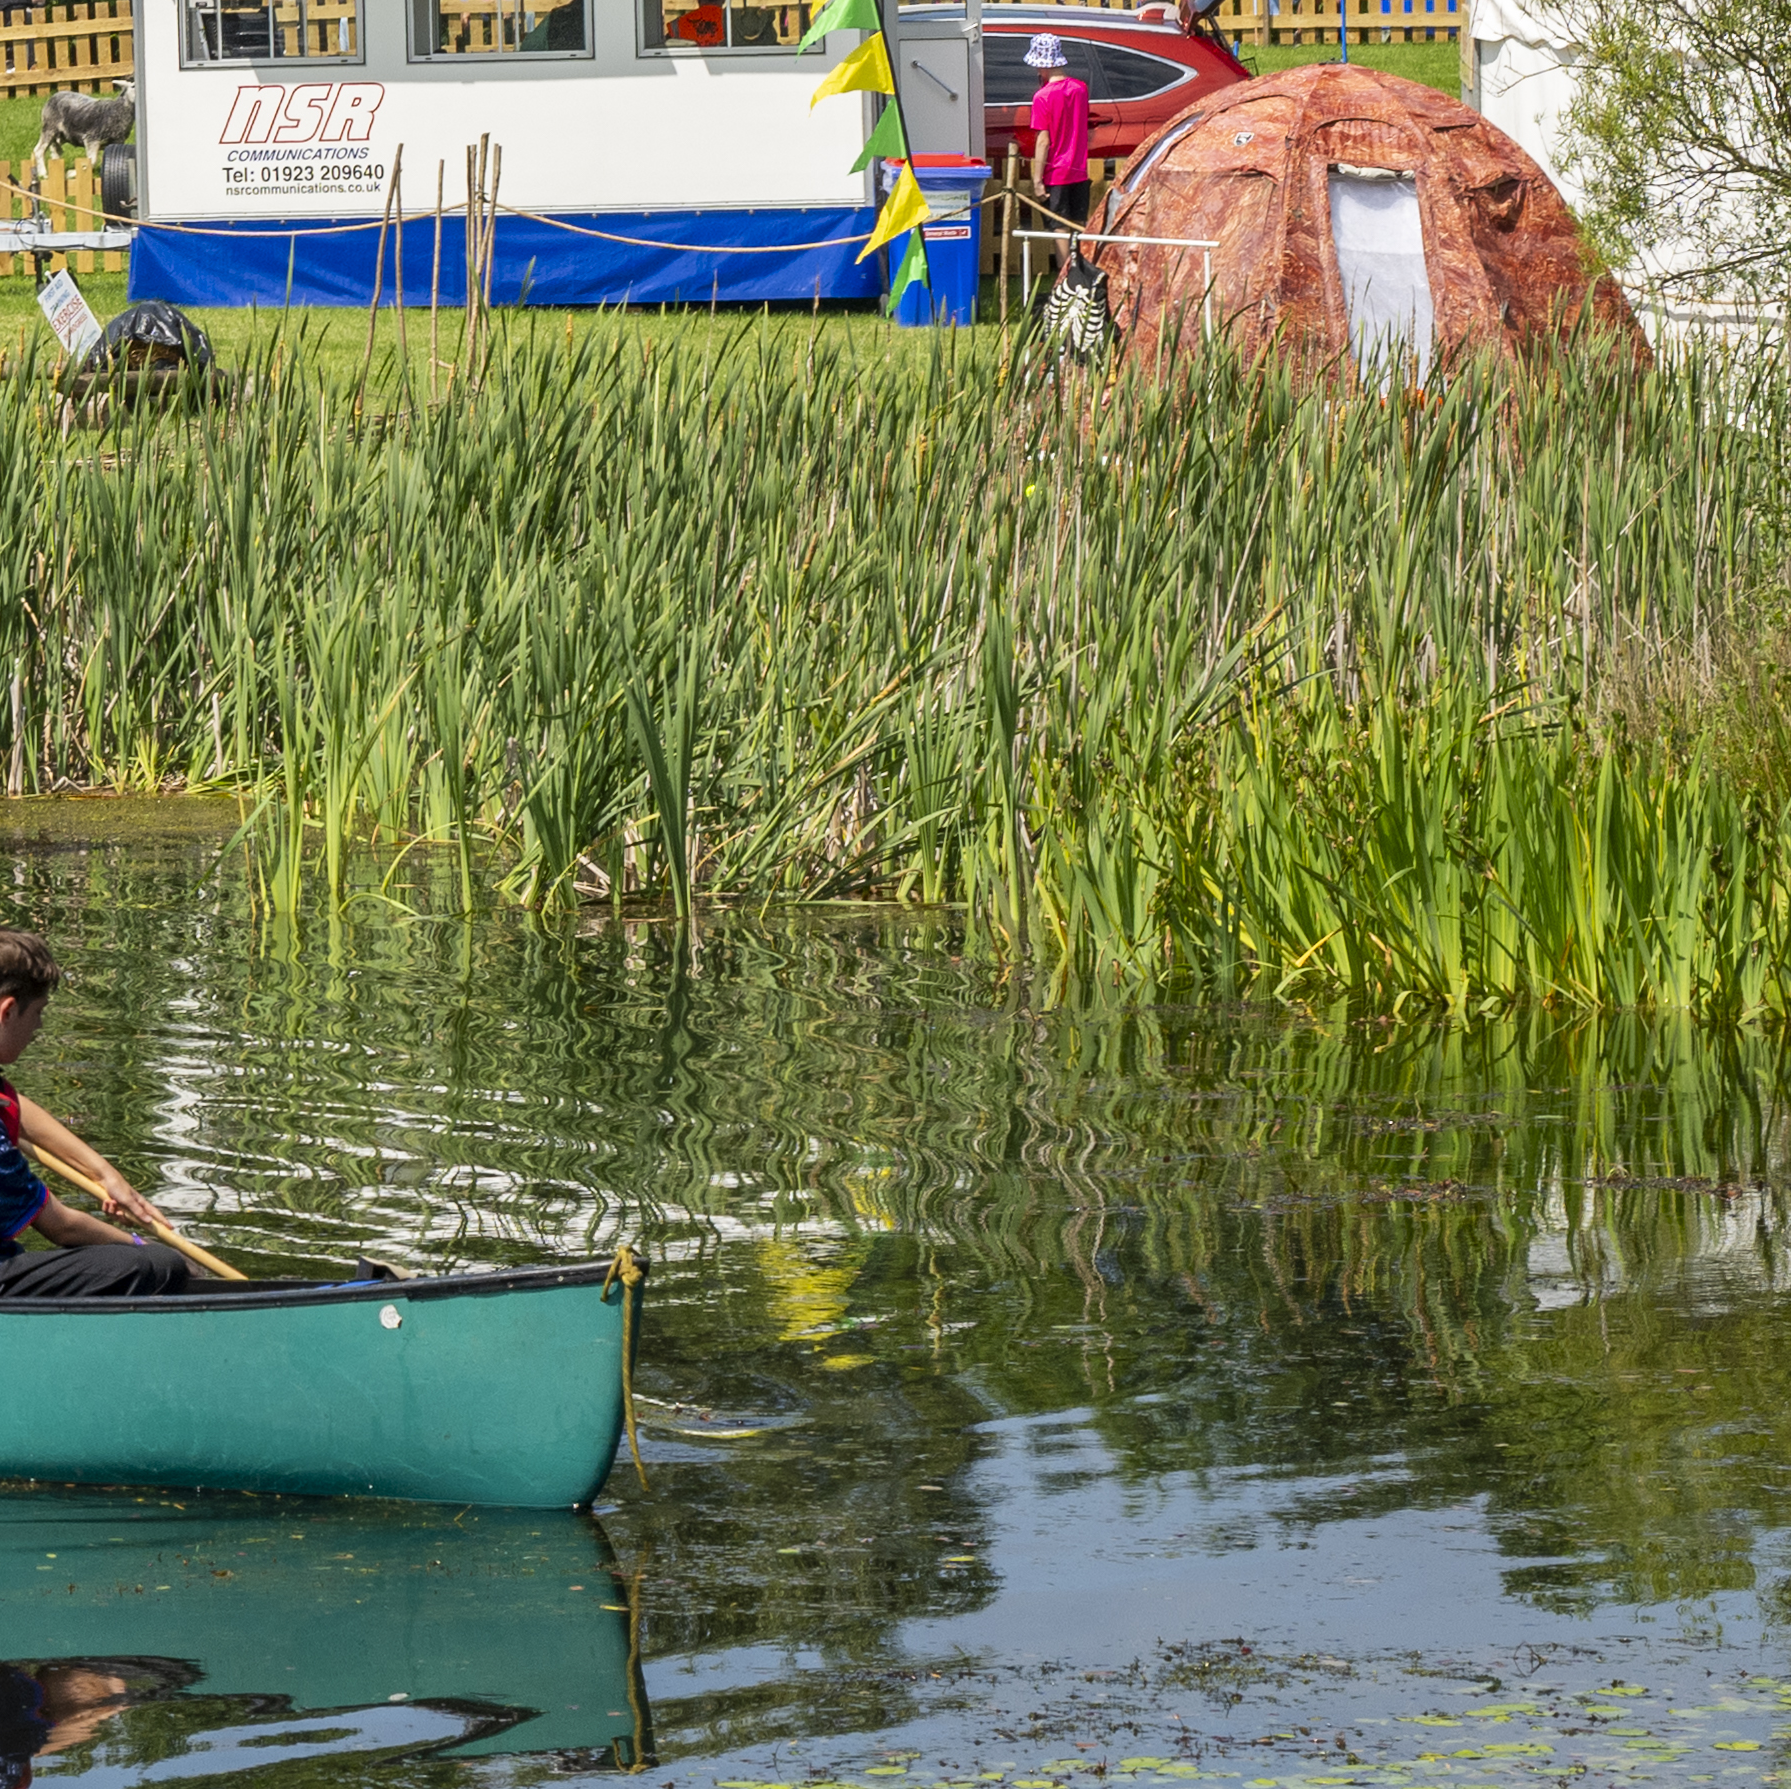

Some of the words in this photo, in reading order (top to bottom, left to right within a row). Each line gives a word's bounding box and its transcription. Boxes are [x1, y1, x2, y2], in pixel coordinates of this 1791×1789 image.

[227, 147, 369, 162] COMMUNICATIONS
[222, 167, 255, 183] Tel:
[261, 166, 314, 183] 01923
[321, 164, 384, 181] 209640
[226, 182, 381, 196] nsrcommunications.co.uk
